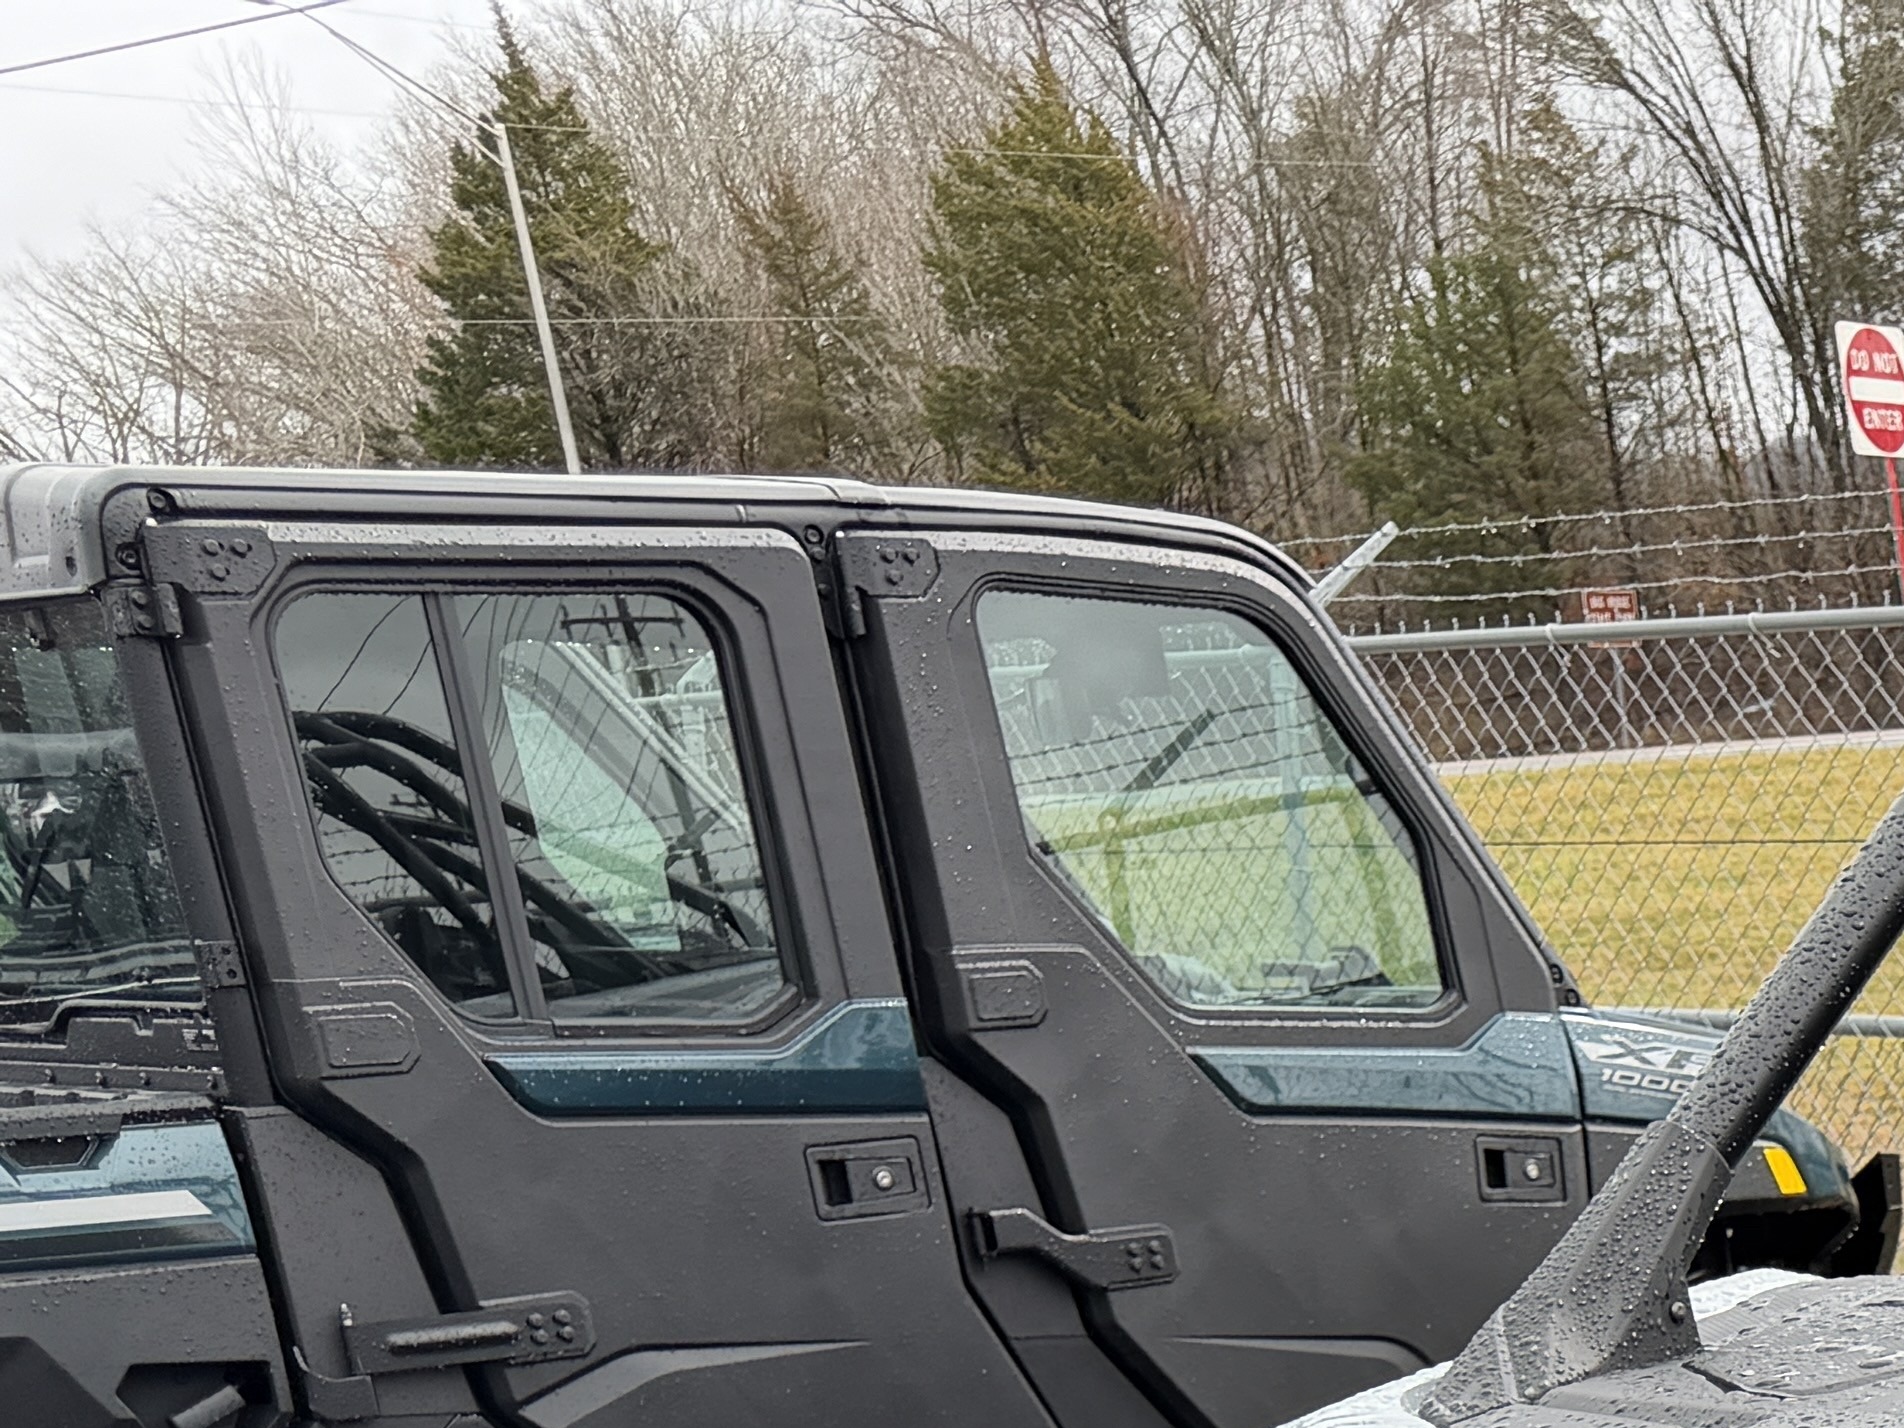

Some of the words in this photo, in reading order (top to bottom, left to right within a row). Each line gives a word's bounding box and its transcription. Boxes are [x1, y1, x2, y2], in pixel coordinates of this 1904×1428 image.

[1850, 348, 1869, 372] DO
[1873, 352, 1899, 374] NOT
[1863, 408, 1903, 431] ENTER
